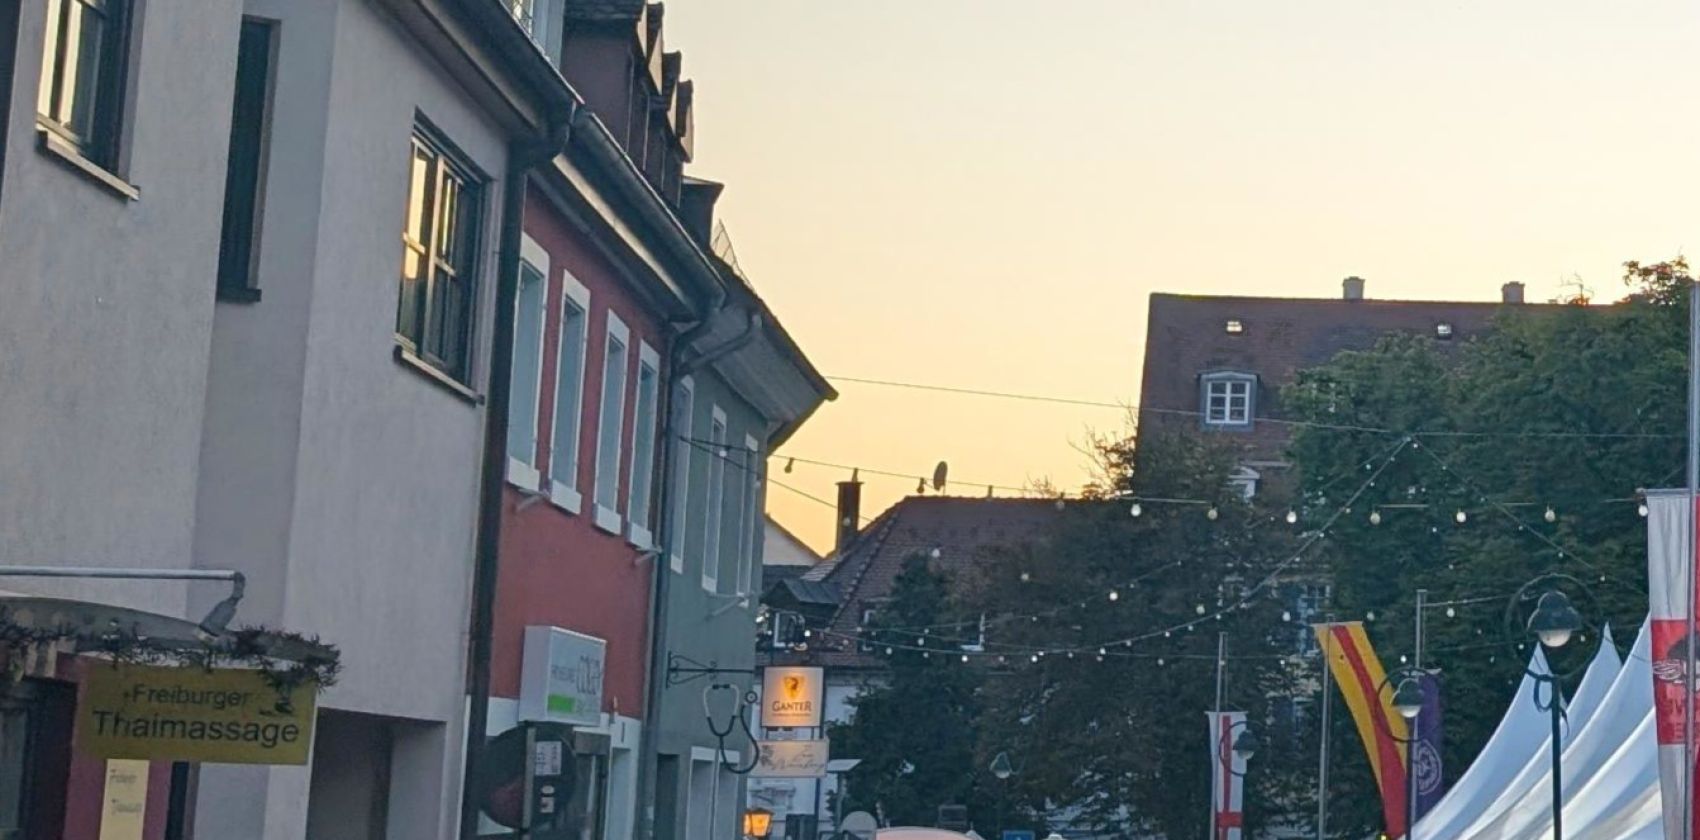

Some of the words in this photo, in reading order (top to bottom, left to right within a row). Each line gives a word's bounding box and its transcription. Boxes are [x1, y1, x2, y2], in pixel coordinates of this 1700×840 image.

[132, 684, 252, 709] Freiburger
[772, 701, 812, 712] GANTER
[93, 711, 299, 748] Thaimassage
